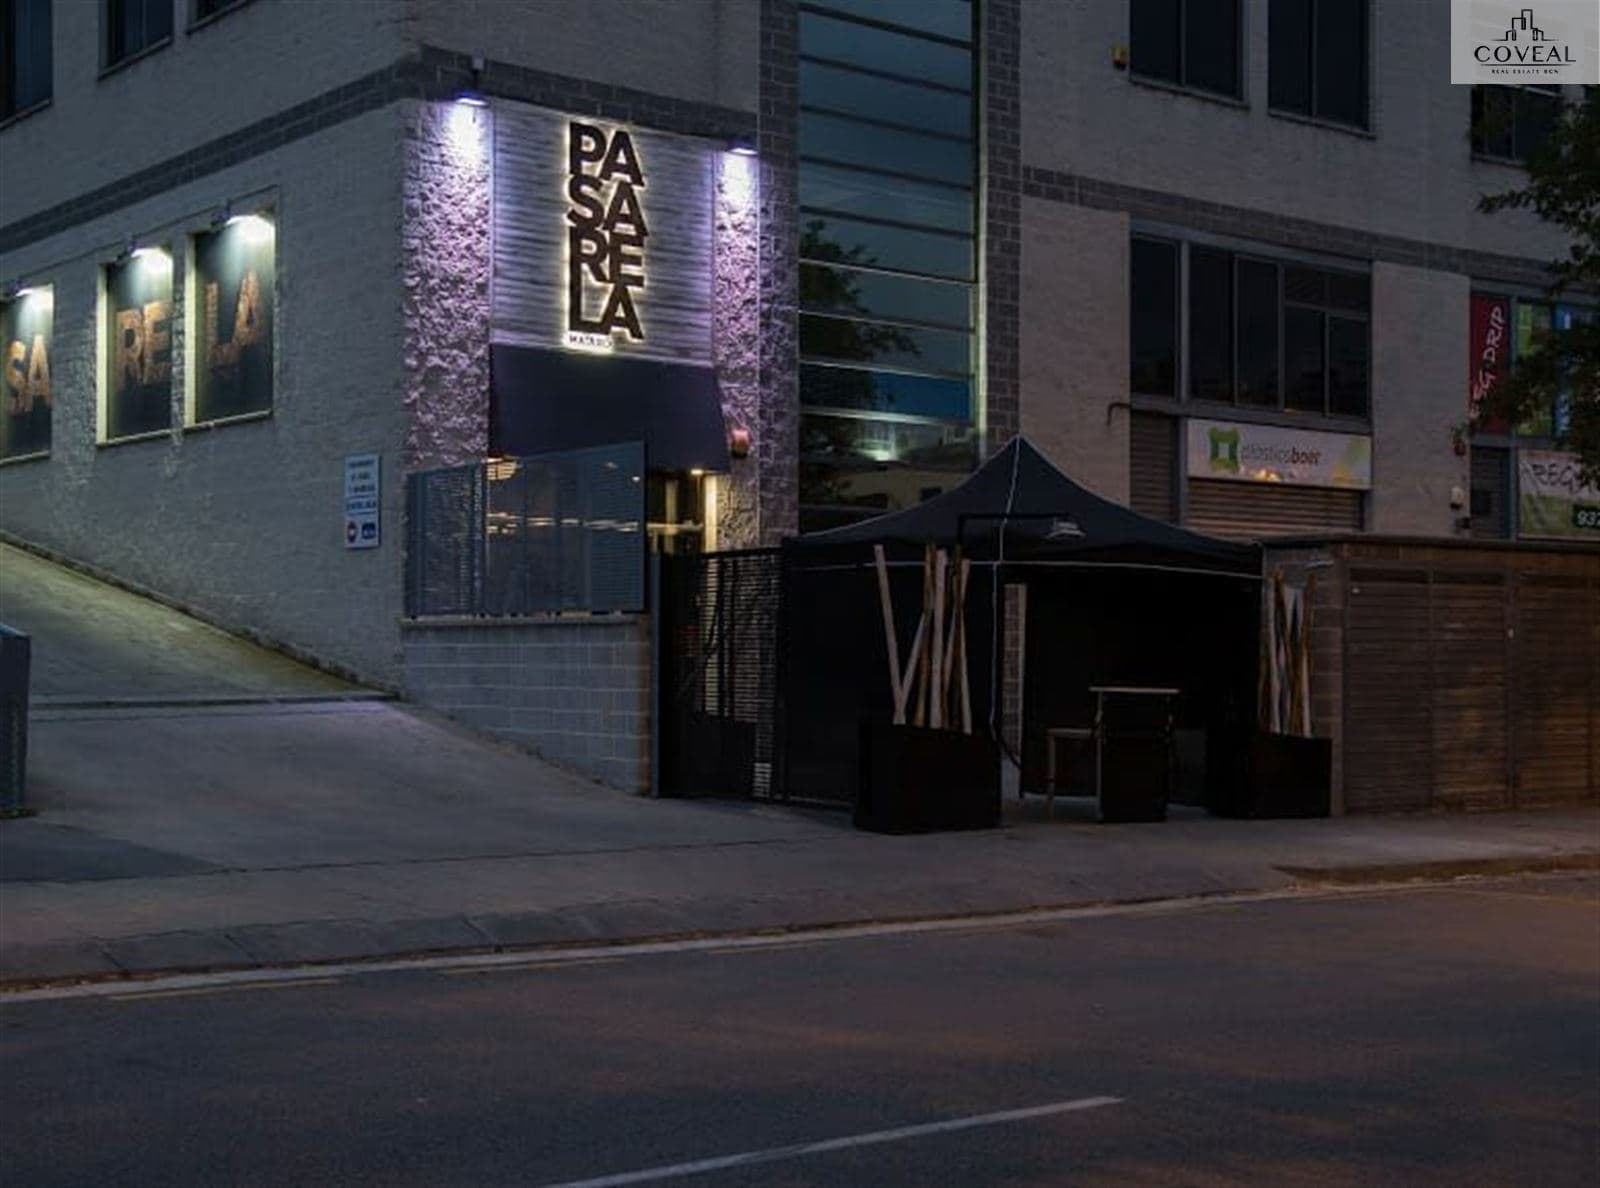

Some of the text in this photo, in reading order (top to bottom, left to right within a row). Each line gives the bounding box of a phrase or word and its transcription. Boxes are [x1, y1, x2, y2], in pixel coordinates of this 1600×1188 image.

[569, 121, 645, 187] PA
[567, 174, 648, 236] SA
[569, 227, 645, 288] RE
[205, 270, 263, 378] LA
[569, 279, 644, 340] LA
[5, 335, 52, 417] SA
[115, 301, 171, 392] RE
